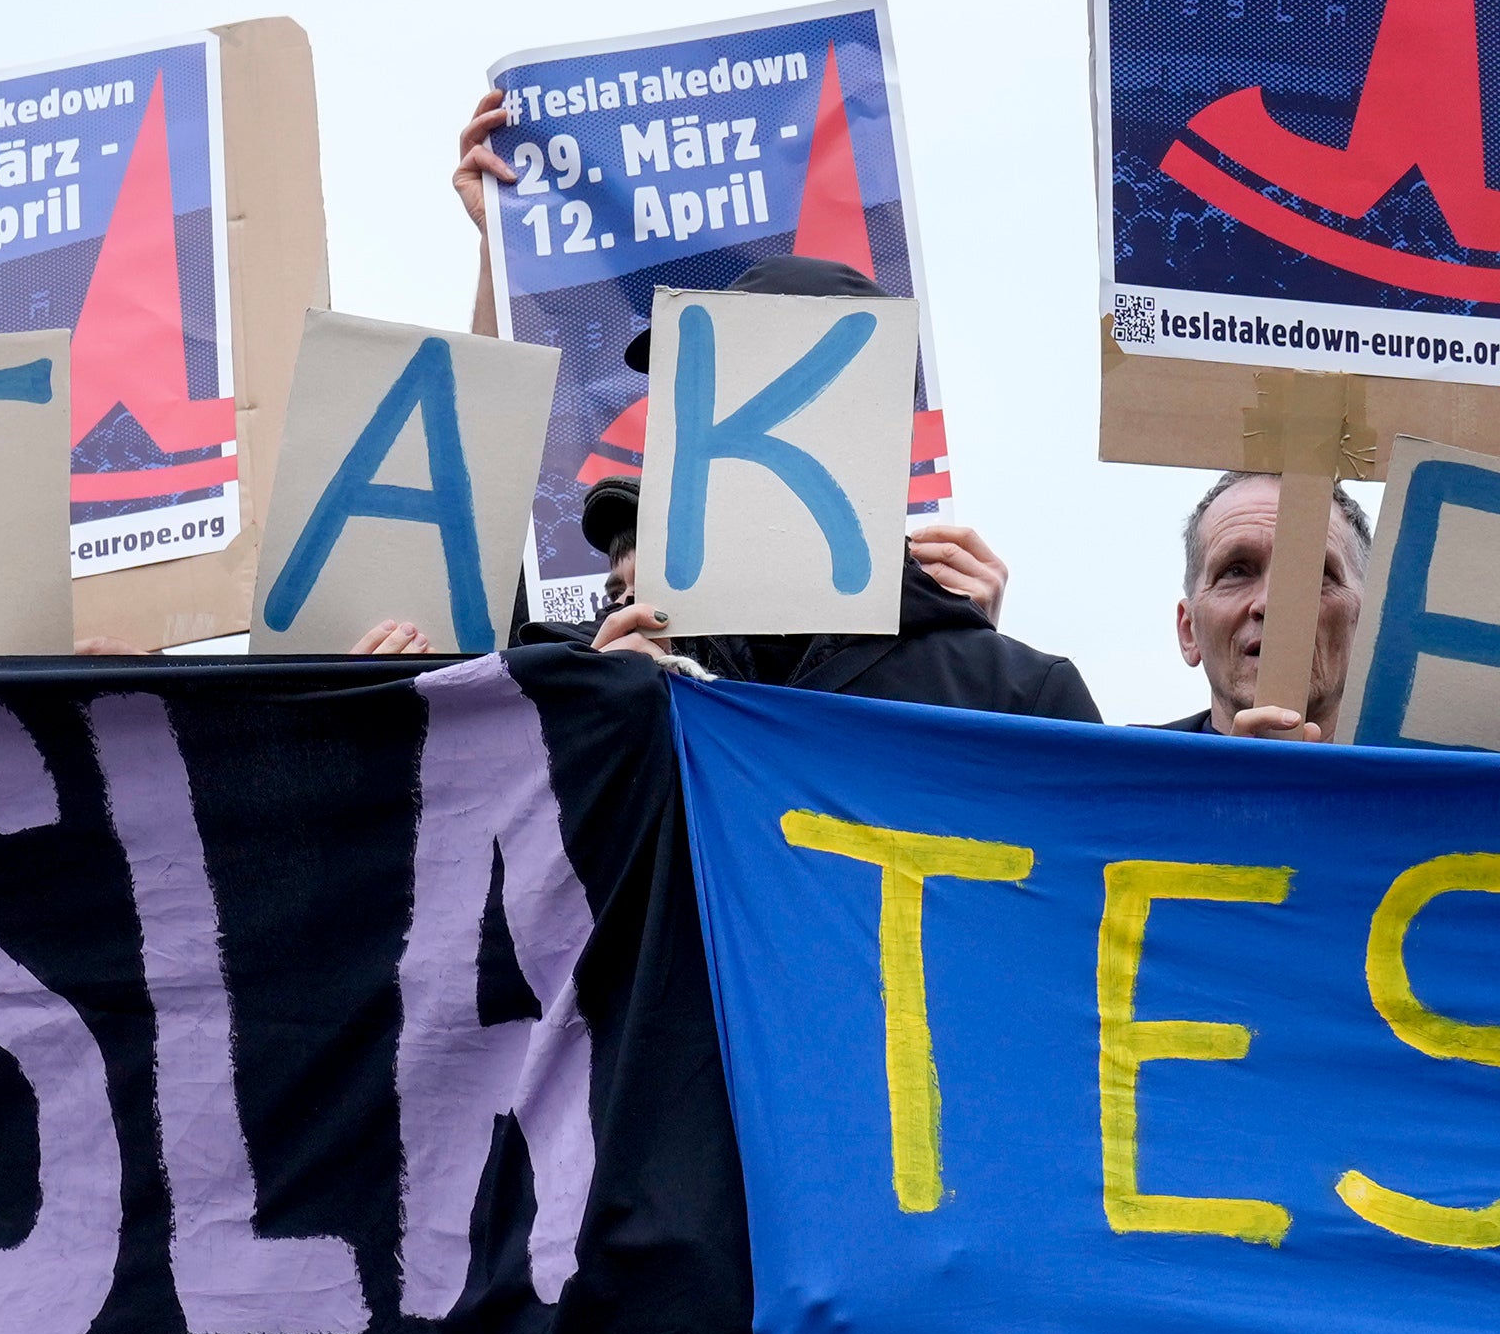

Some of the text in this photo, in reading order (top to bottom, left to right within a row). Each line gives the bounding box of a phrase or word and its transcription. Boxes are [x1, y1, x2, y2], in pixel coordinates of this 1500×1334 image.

[505, 50, 808, 128] #TeslaTakedown
[100, 142, 117, 155] -
[514, 116, 798, 197] 29. März -
[522, 170, 768, 258] 12. April
[664, 304, 877, 595] K
[264, 337, 497, 653] A
[70, 515, 225, 561] -europe.org
